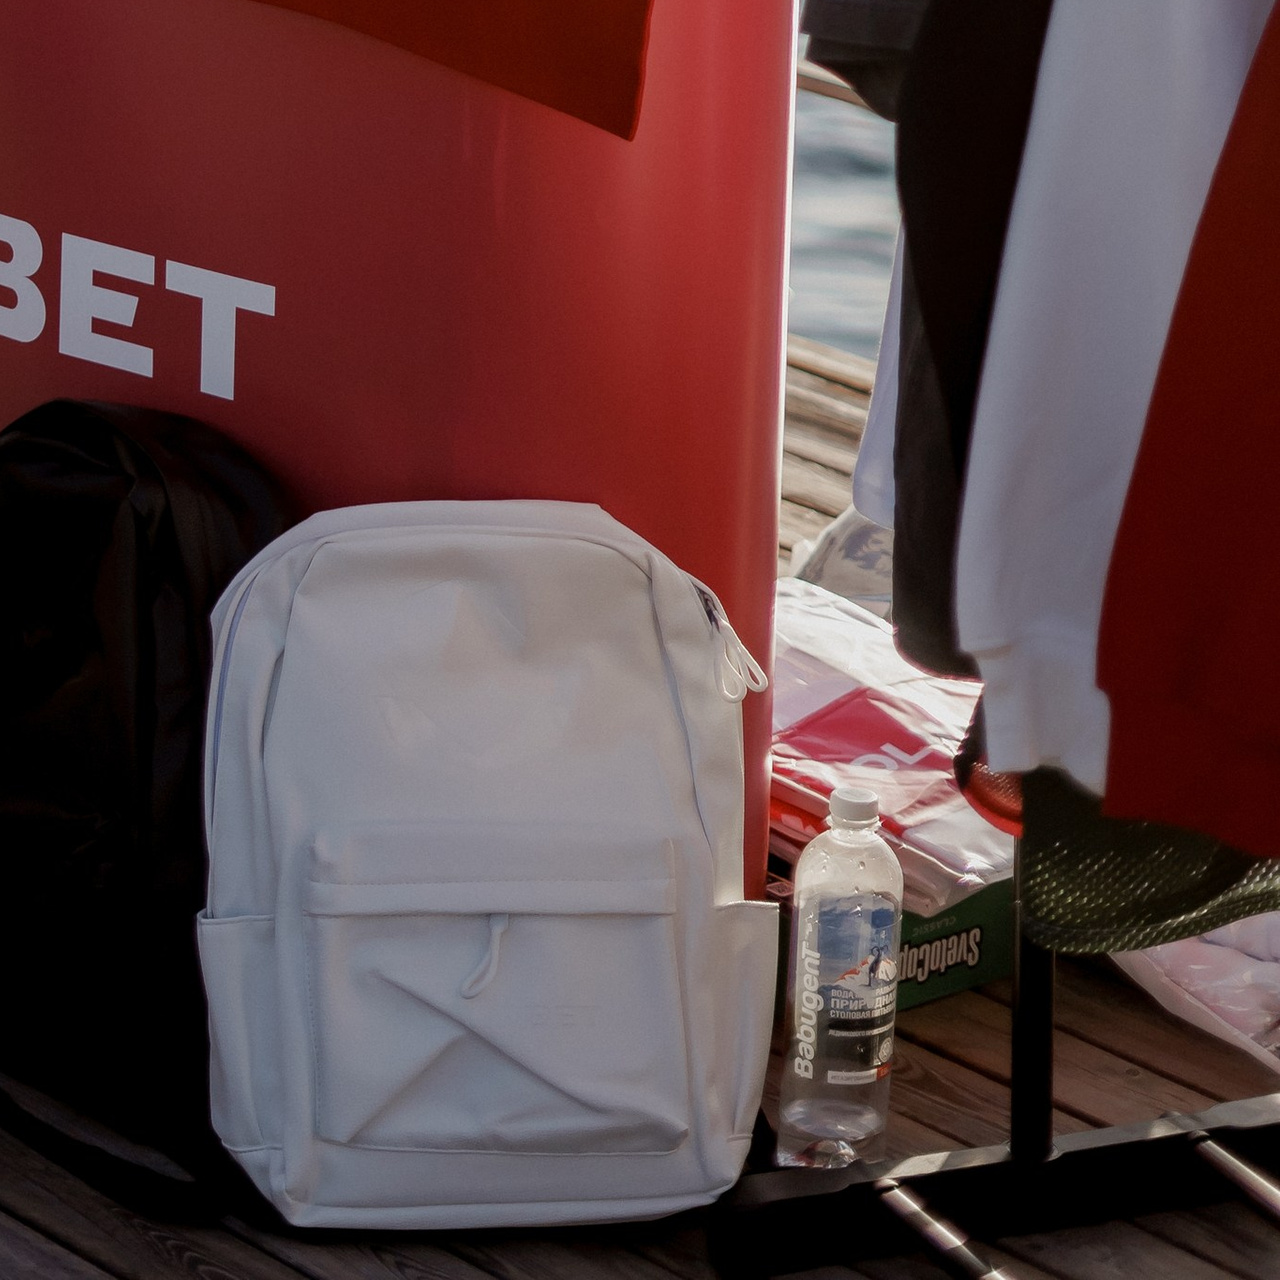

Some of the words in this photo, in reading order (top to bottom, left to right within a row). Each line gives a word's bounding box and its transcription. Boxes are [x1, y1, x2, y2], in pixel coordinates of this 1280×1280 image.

[900, 928, 980, 982] SvetoCop
[831, 989, 855, 999] ВОДА
[830, 1009, 871, 1020] СТОЛОВАЯ
